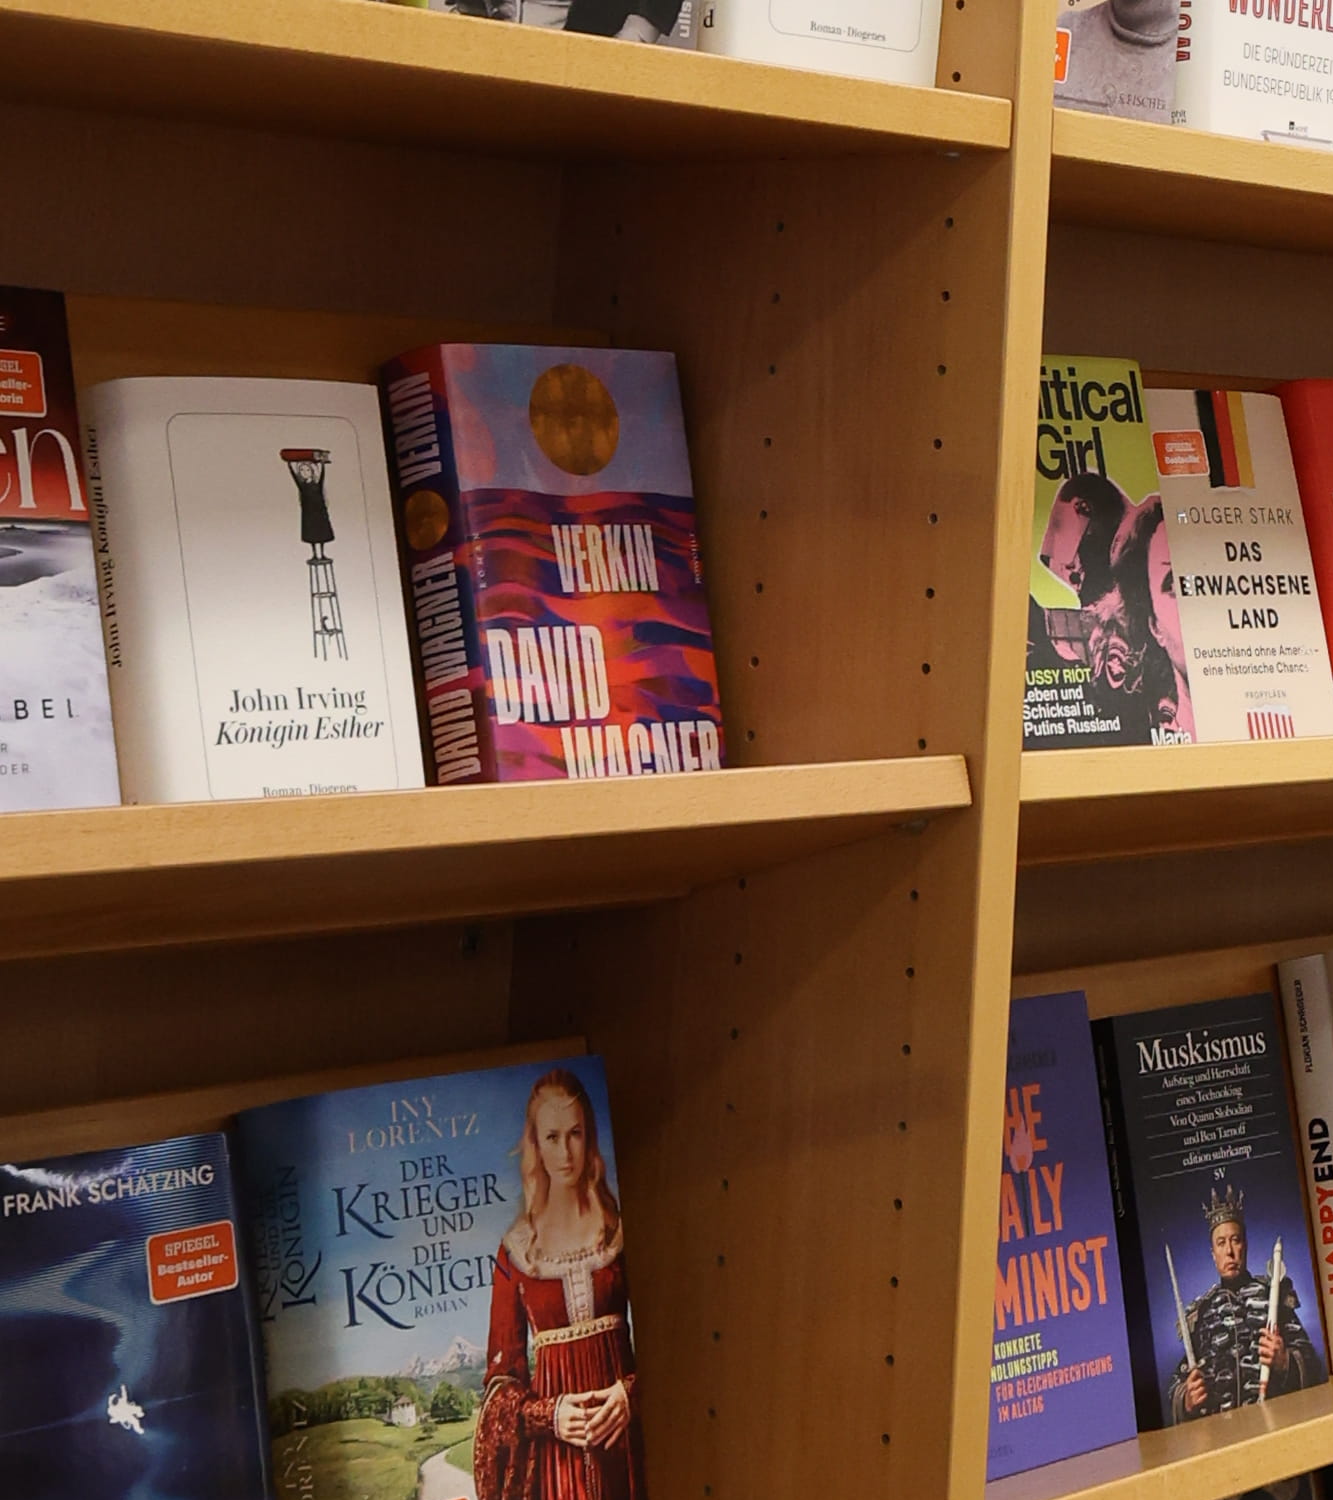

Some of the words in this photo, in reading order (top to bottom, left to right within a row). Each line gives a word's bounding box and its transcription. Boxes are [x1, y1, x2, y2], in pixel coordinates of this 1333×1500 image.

[1243, 43, 1261, 61] DIE
[551, 524, 660, 592] VERKIN
[1225, 540, 1262, 563] DAS
[486, 625, 609, 725] DAVID
[229, 686, 289, 714] John
[295, 685, 368, 712] Irving
[1082, 702, 1095, 716] in
[215, 719, 310, 750] Königin
[314, 714, 385, 744] Esther
[1136, 1030, 1266, 1075] Muskismus
[400, 1152, 451, 1185] DER
[335, 1170, 508, 1241] KRIEGER
[412, 1239, 451, 1265] DIE
